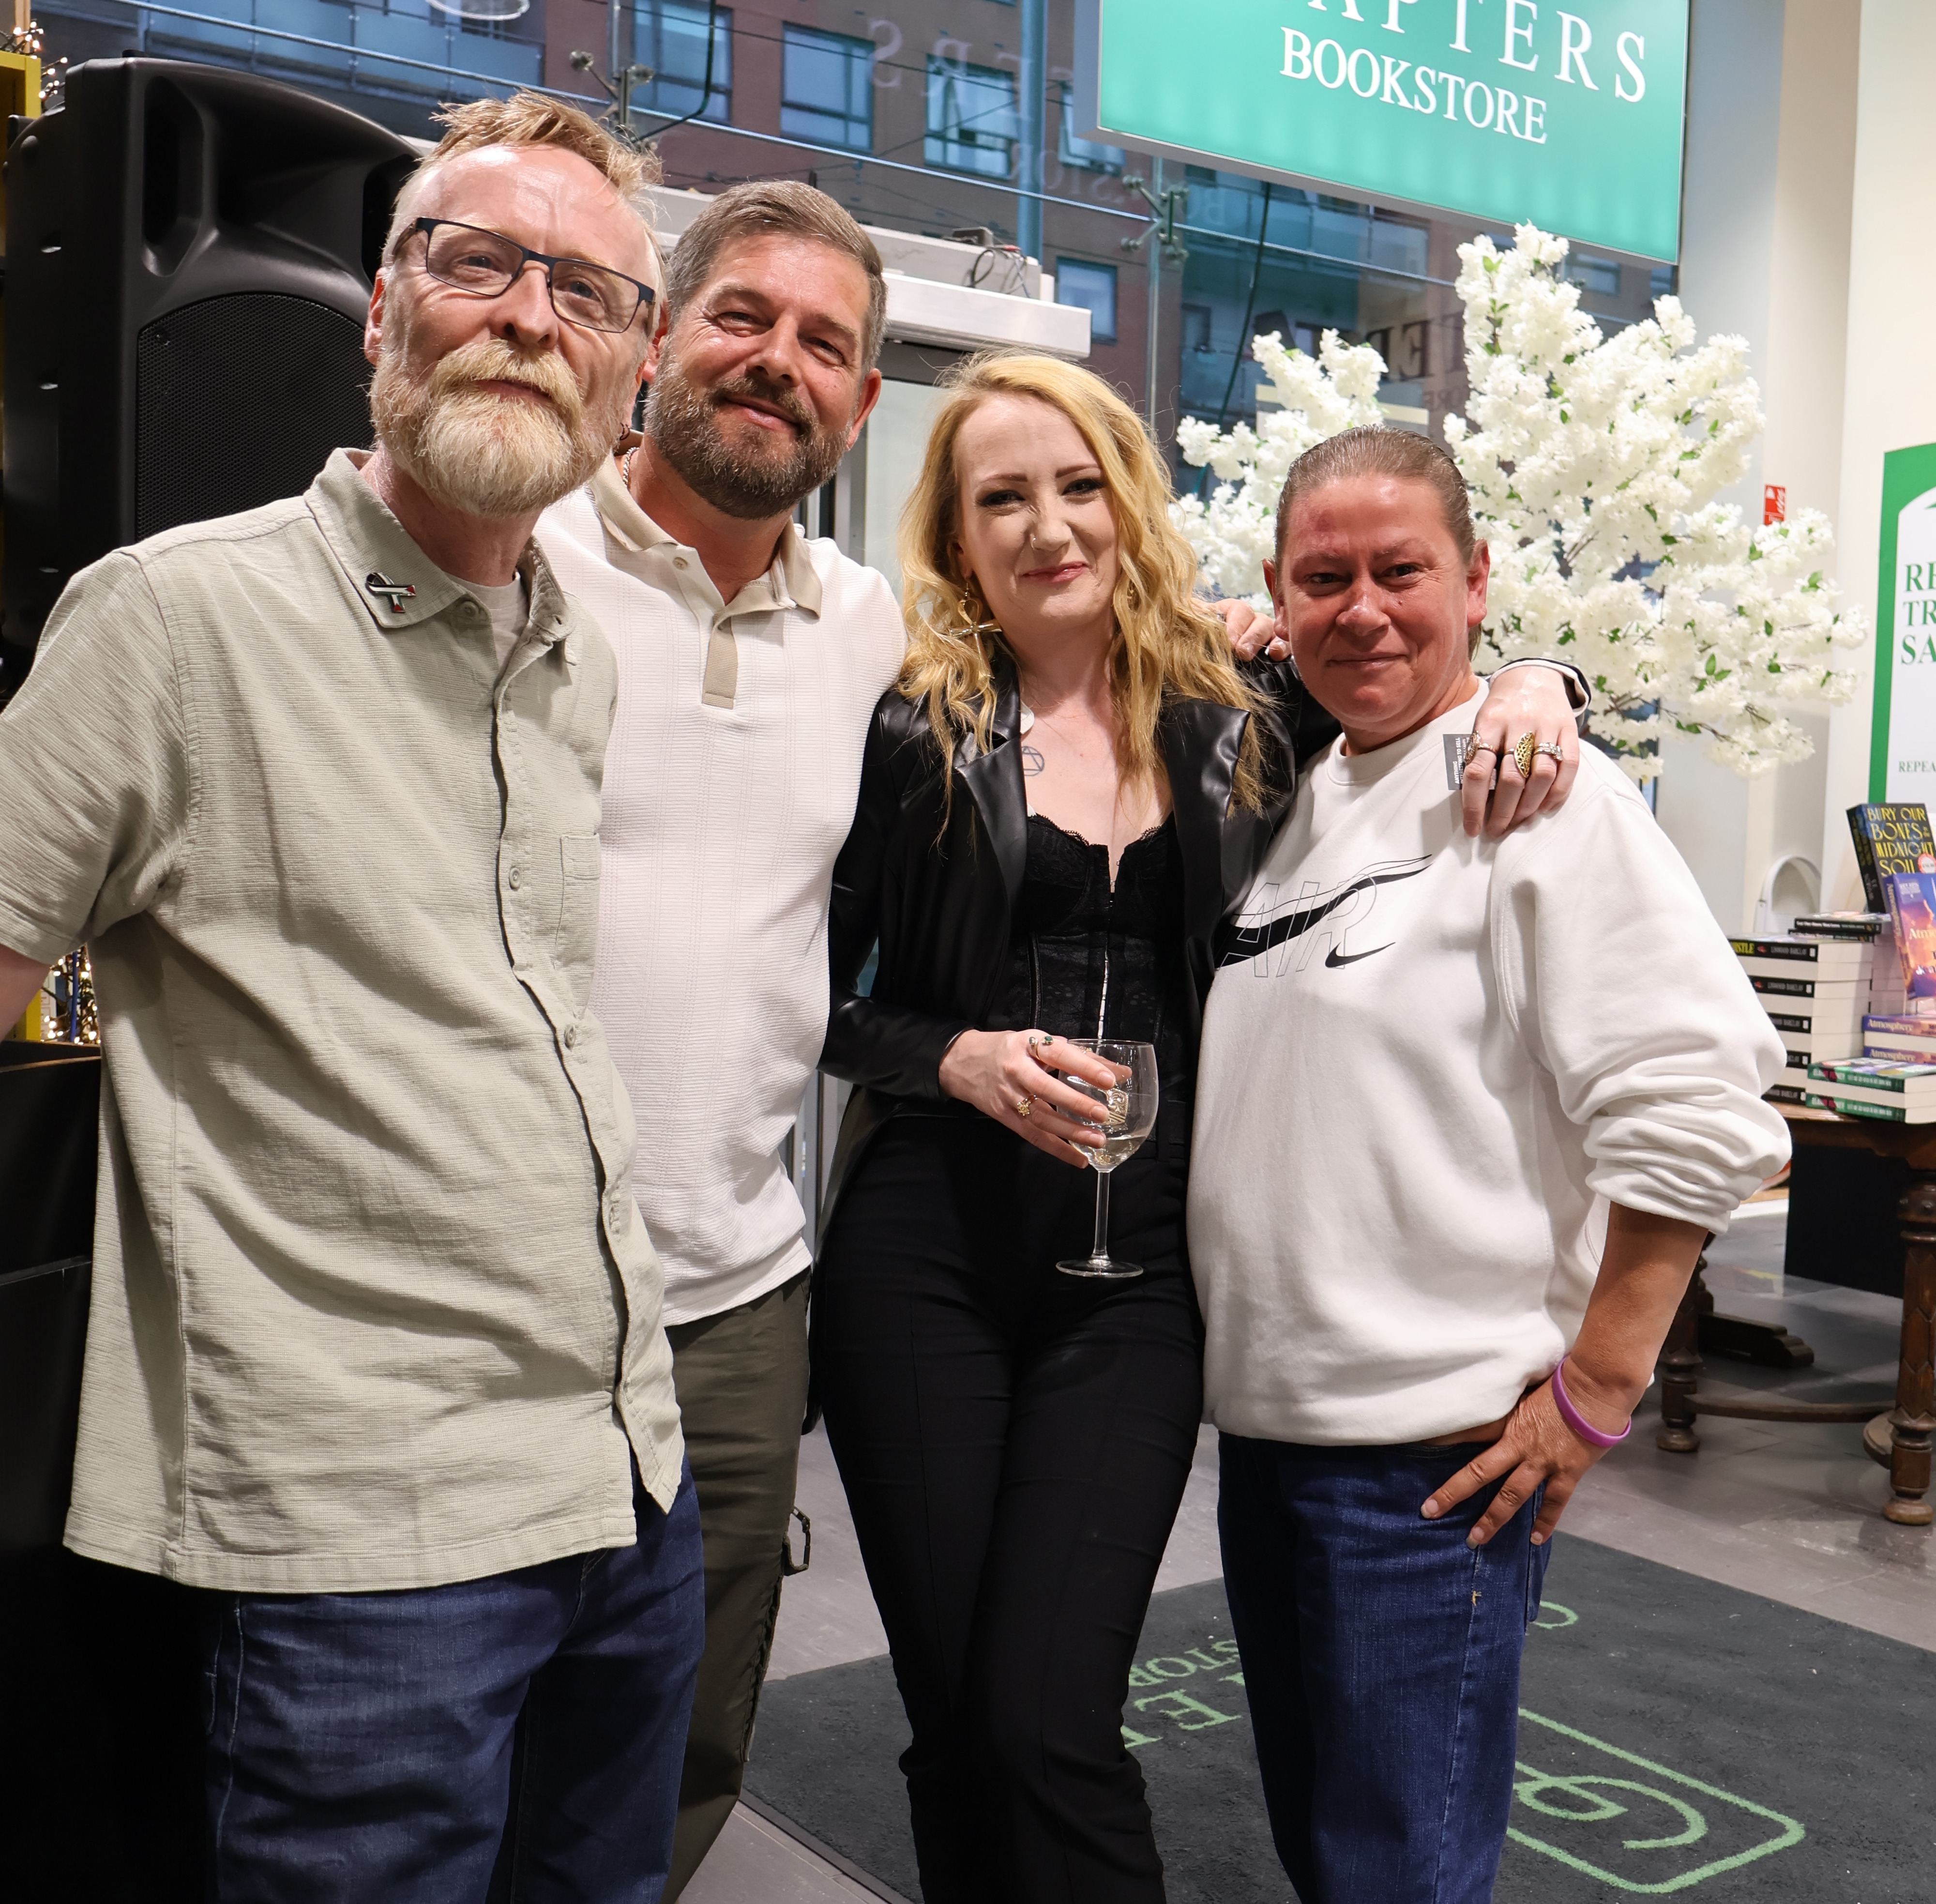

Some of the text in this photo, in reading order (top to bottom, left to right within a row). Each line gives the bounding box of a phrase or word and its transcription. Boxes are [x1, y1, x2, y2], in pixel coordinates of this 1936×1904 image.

[1280, 26, 1549, 145] BOOKSTORE
[1867, 807, 1926, 821] BURY OUR
[1870, 823, 1923, 841] BONES
[1875, 842, 1935, 858] MIDNIGHT
[1215, 873, 1377, 978] AIR
[1868, 1018, 1914, 1031] Atmosphere
[1870, 1049, 1917, 1062] Atmosphere
